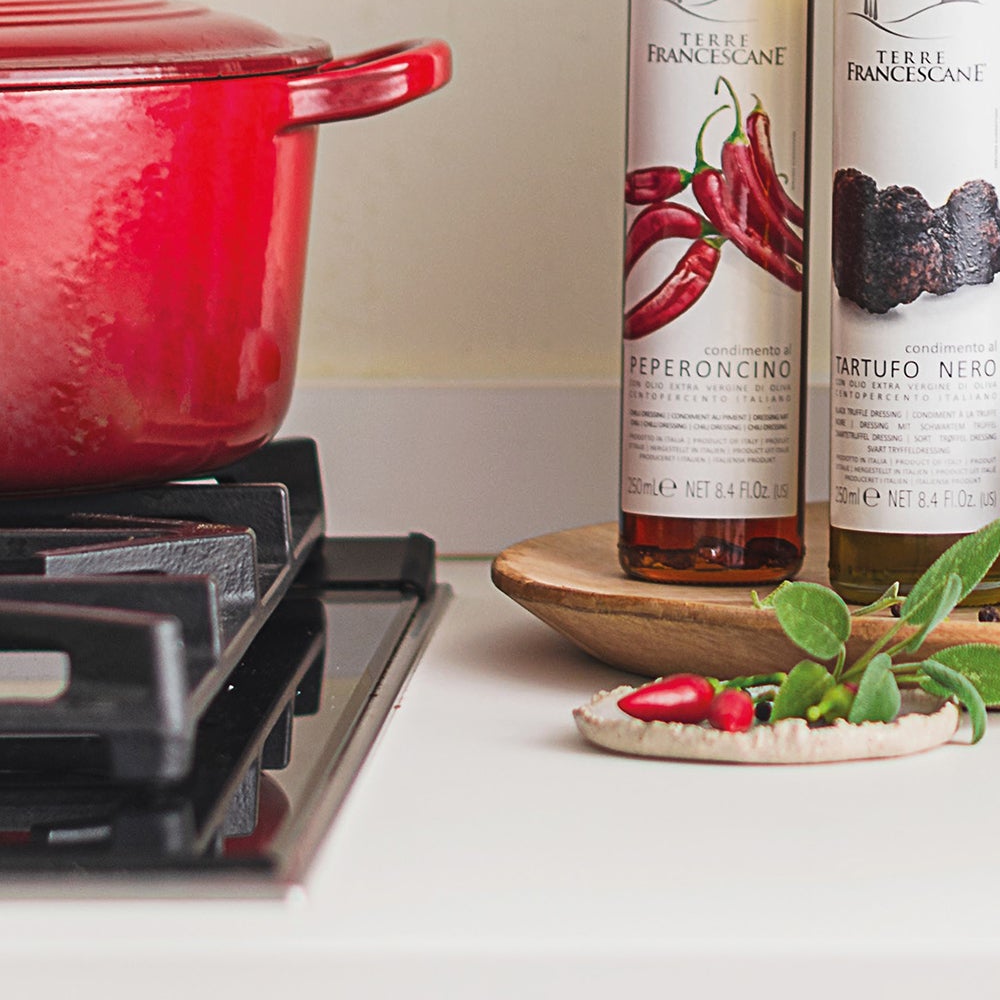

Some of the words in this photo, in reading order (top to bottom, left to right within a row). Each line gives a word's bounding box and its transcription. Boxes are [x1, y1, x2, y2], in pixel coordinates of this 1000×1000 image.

[680, 32, 750, 47] TERRE
[648, 43, 787, 66] FRANCESCANE
[876, 50, 944, 64] TERRE
[848, 61, 986, 82] FRANCESCANE
[705, 344, 781, 356] condimento
[783, 343, 792, 356] al
[905, 343, 985, 354] condimento
[988, 341, 997, 353] al
[631, 355, 791, 379] PEPERONCINO
[836, 356, 919, 379] TARTUFO
[939, 359, 996, 379] NERO
[670, 383, 699, 392] EXTRA
[849, 380, 866, 389] OLIO
[871, 381, 901, 390] EXTRA
[908, 382, 951, 391] VERGINE
[938, 392, 998, 402] ITALIANO
[685, 480, 710, 498] NET
[715, 481, 735, 499] 8.4
[888, 489, 913, 508] NET
[918, 490, 938, 509] 8.4
